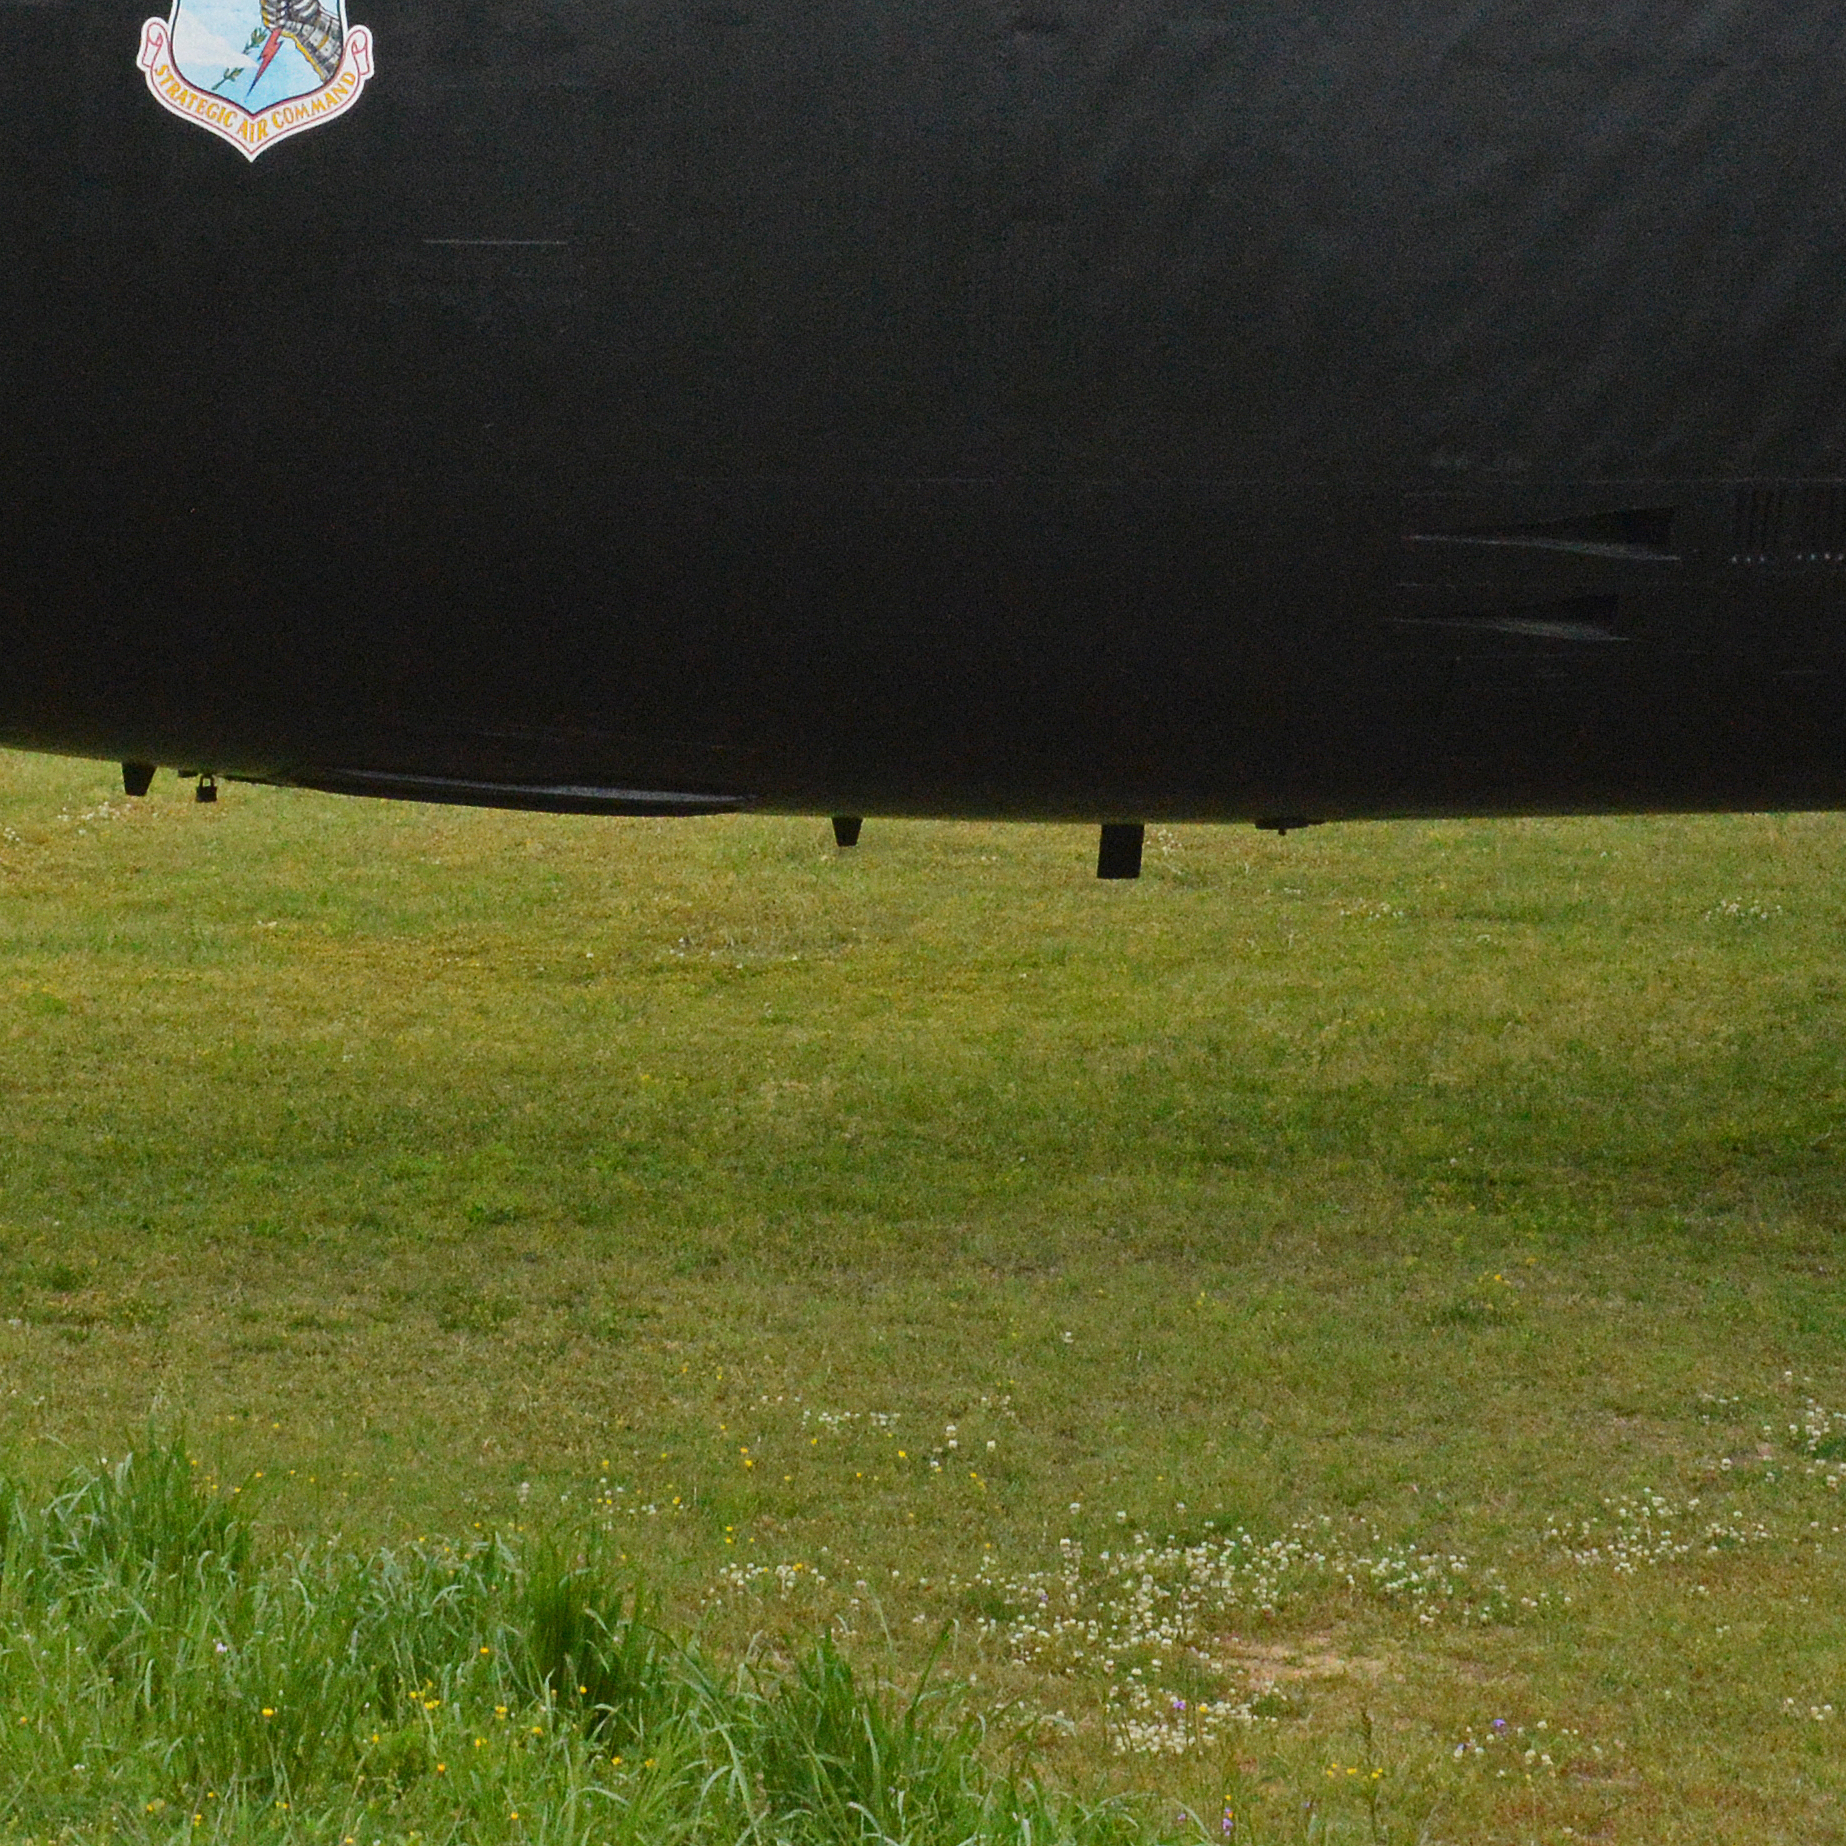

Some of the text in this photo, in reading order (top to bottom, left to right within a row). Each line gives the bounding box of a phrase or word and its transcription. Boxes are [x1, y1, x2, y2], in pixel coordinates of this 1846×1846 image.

[155, 65, 356, 143] STRATEGIC AIR COMMAND
